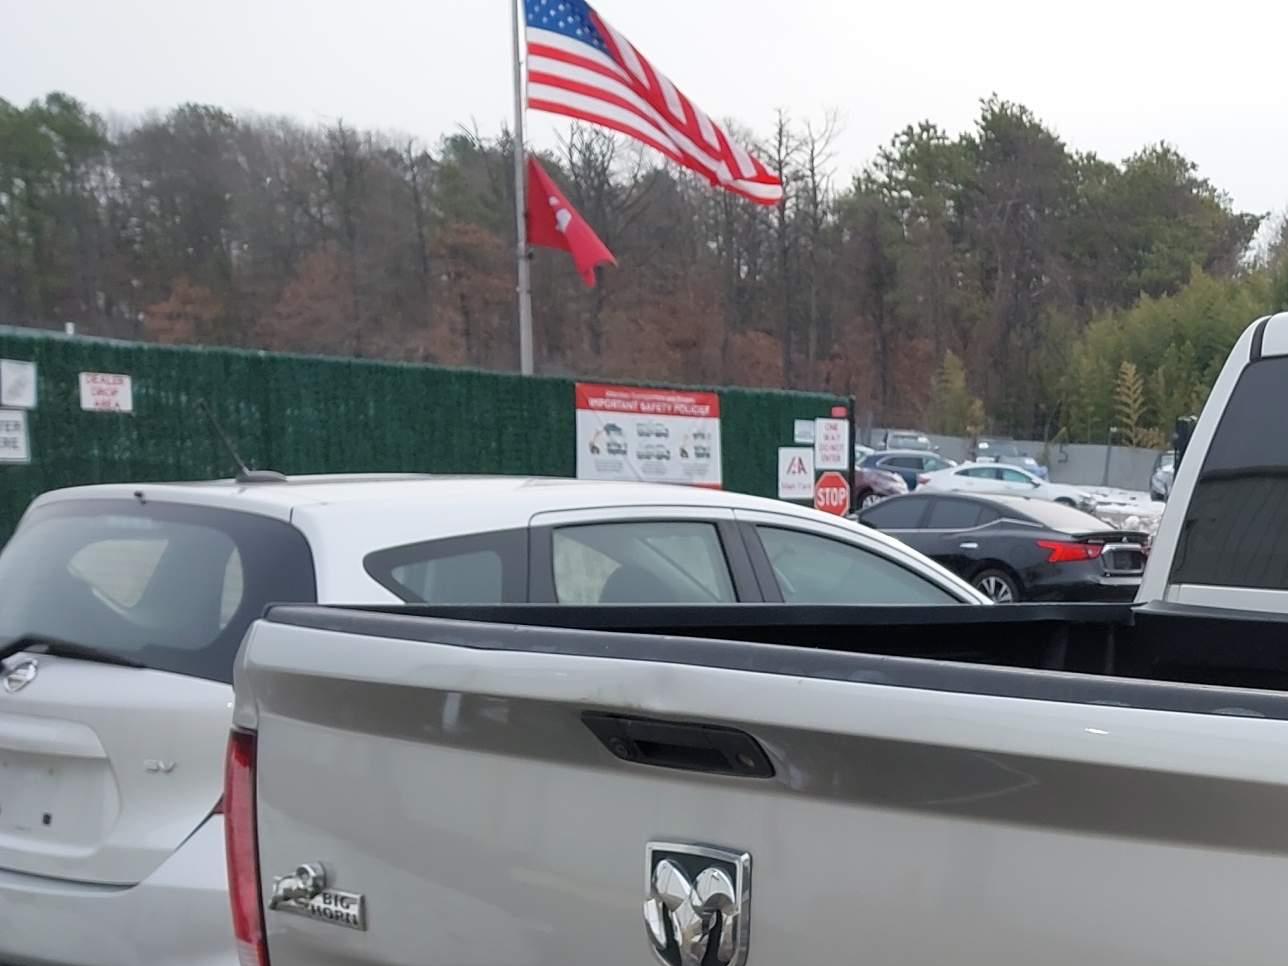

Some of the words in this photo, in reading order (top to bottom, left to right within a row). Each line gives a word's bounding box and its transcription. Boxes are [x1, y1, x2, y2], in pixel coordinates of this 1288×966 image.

[587, 397, 639, 411] IMPORTANT
[640, 400, 672, 414] SAFETY
[817, 487, 847, 507] STOP
[144, 759, 177, 775] SV
[322, 892, 351, 910] BIG
[310, 904, 359, 926] HORN
